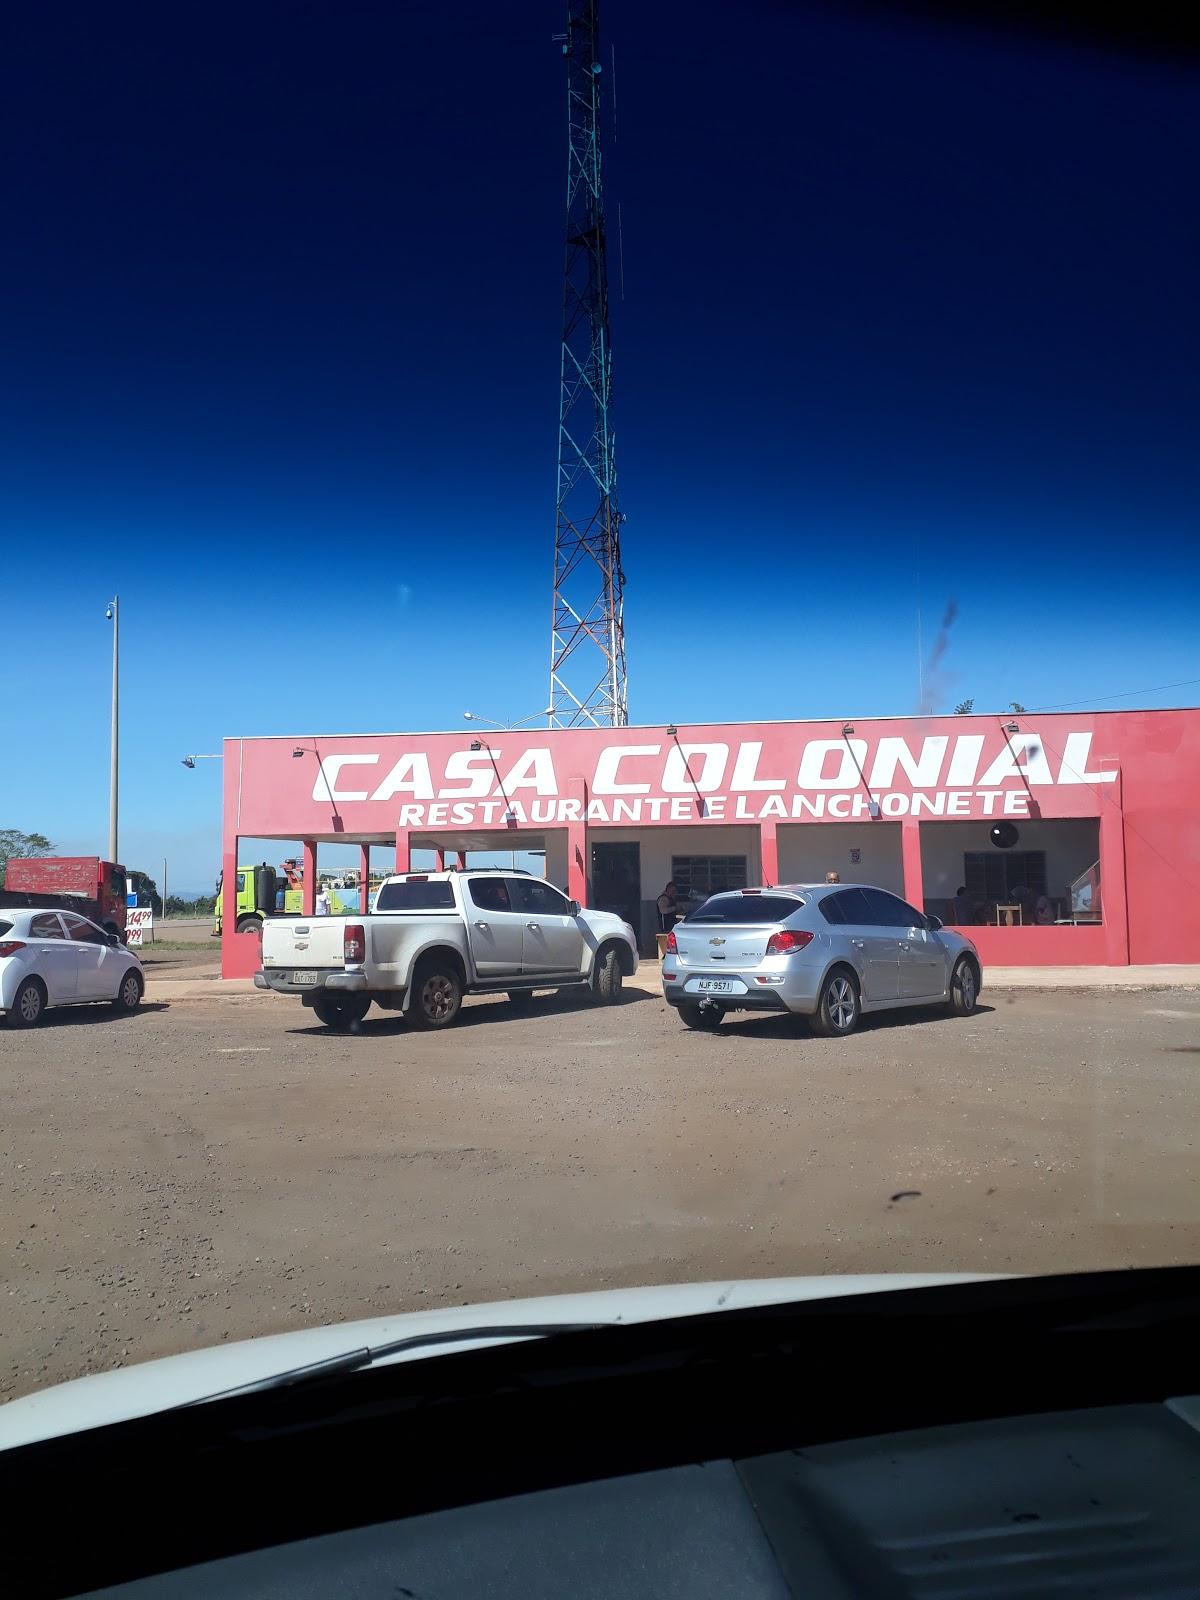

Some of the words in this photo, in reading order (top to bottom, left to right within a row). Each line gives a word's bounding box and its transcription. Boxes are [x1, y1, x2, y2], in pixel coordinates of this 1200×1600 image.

[312, 748, 559, 801] CASA
[592, 732, 1119, 795] COLONIAL
[399, 796, 693, 827] RESTAURANTE
[703, 796, 727, 820] E
[735, 790, 1030, 819] LANCHONETE
